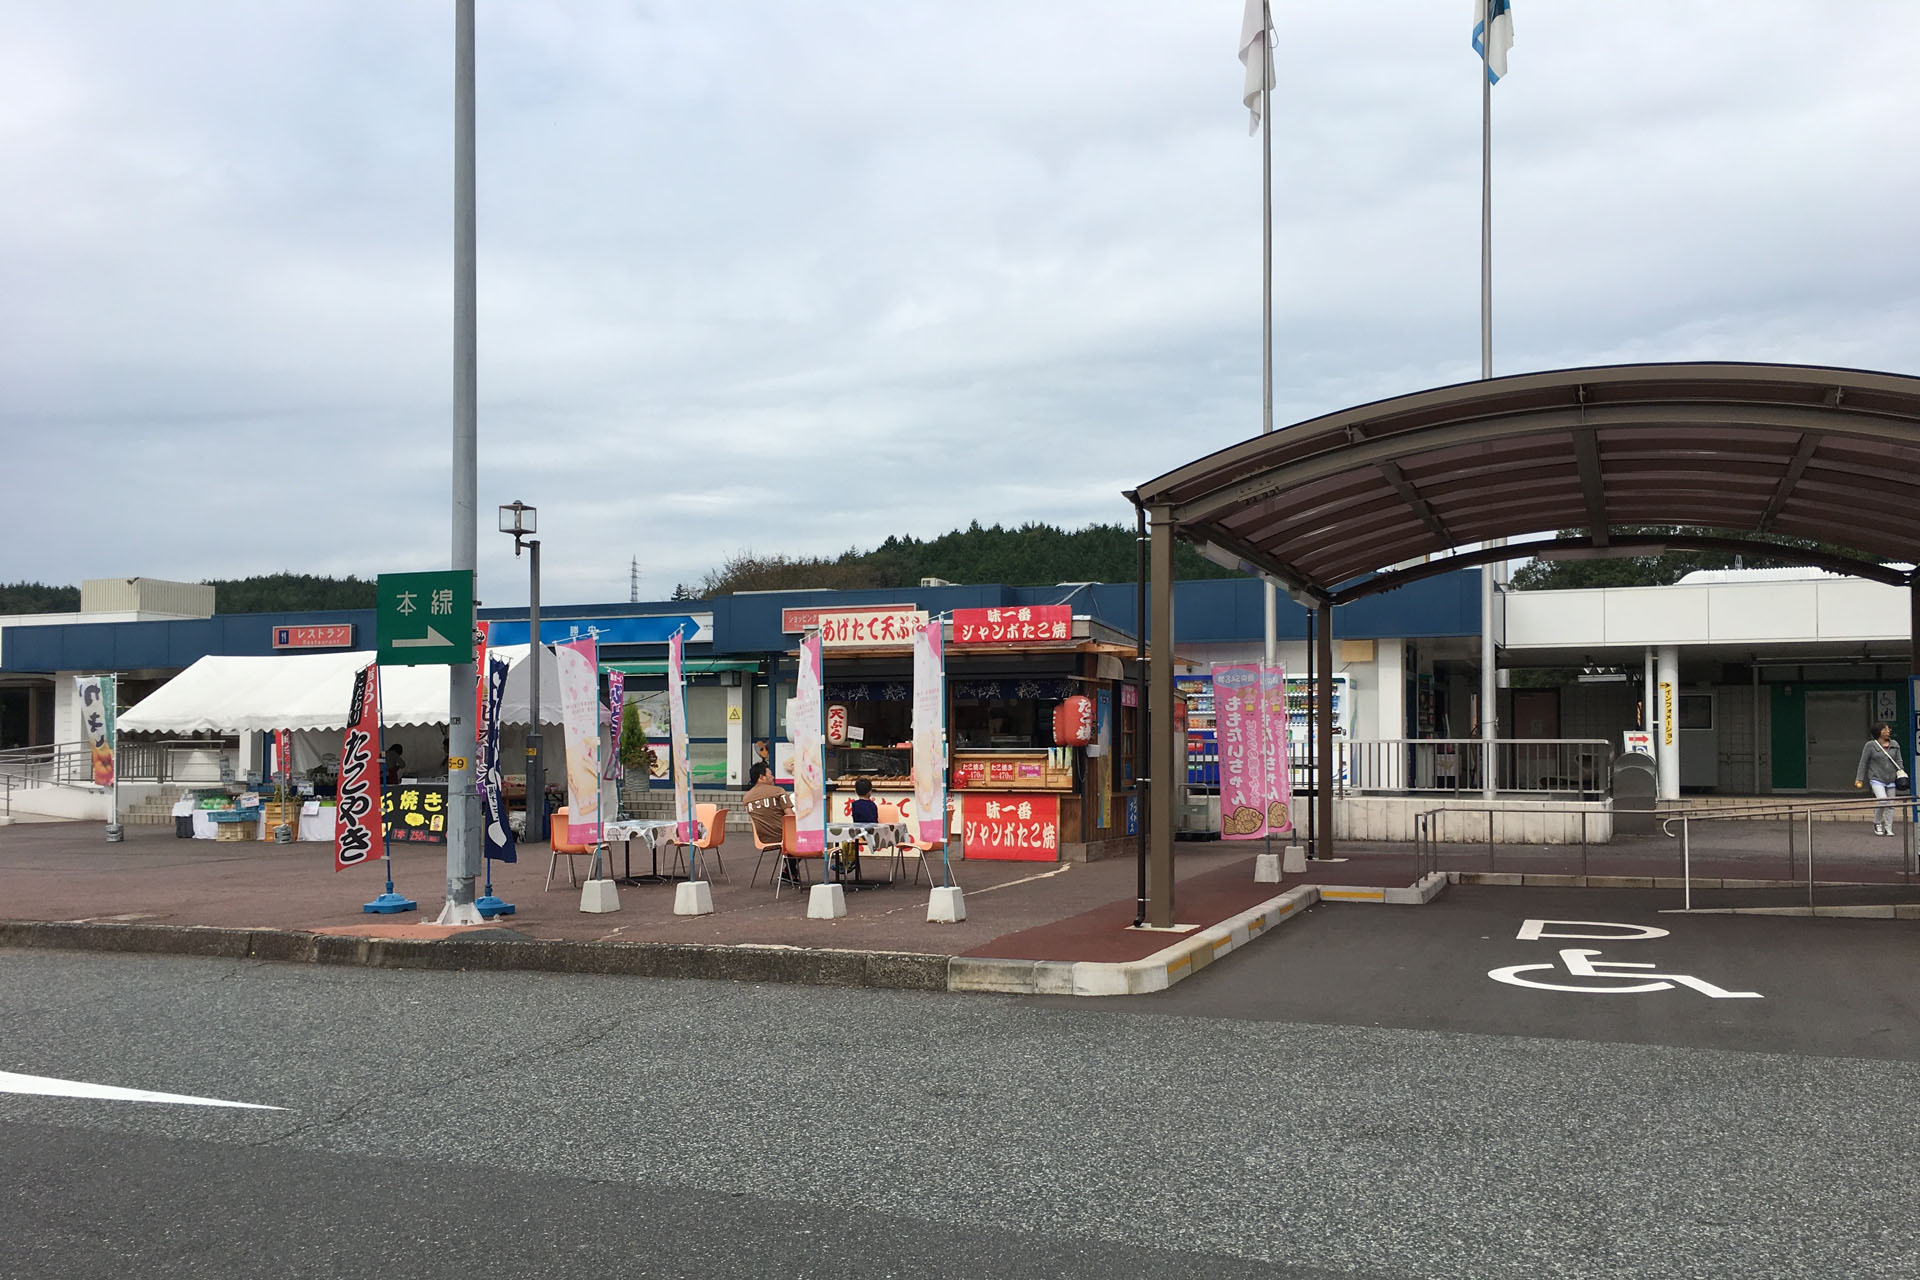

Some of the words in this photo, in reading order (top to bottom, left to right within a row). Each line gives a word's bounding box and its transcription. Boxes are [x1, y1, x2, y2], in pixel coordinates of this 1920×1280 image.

[396, 589, 453, 616] 本線
[987, 607, 1032, 623] 味一番
[297, 628, 345, 639] レストラン
[962, 621, 1066, 641] ジャンボたこ焼
[1665, 689, 1673, 745] インフォメーション
[339, 729, 372, 864] たこやき
[985, 800, 1032, 820] 味一番
[966, 820, 1056, 850] ジャンボたこ焼
